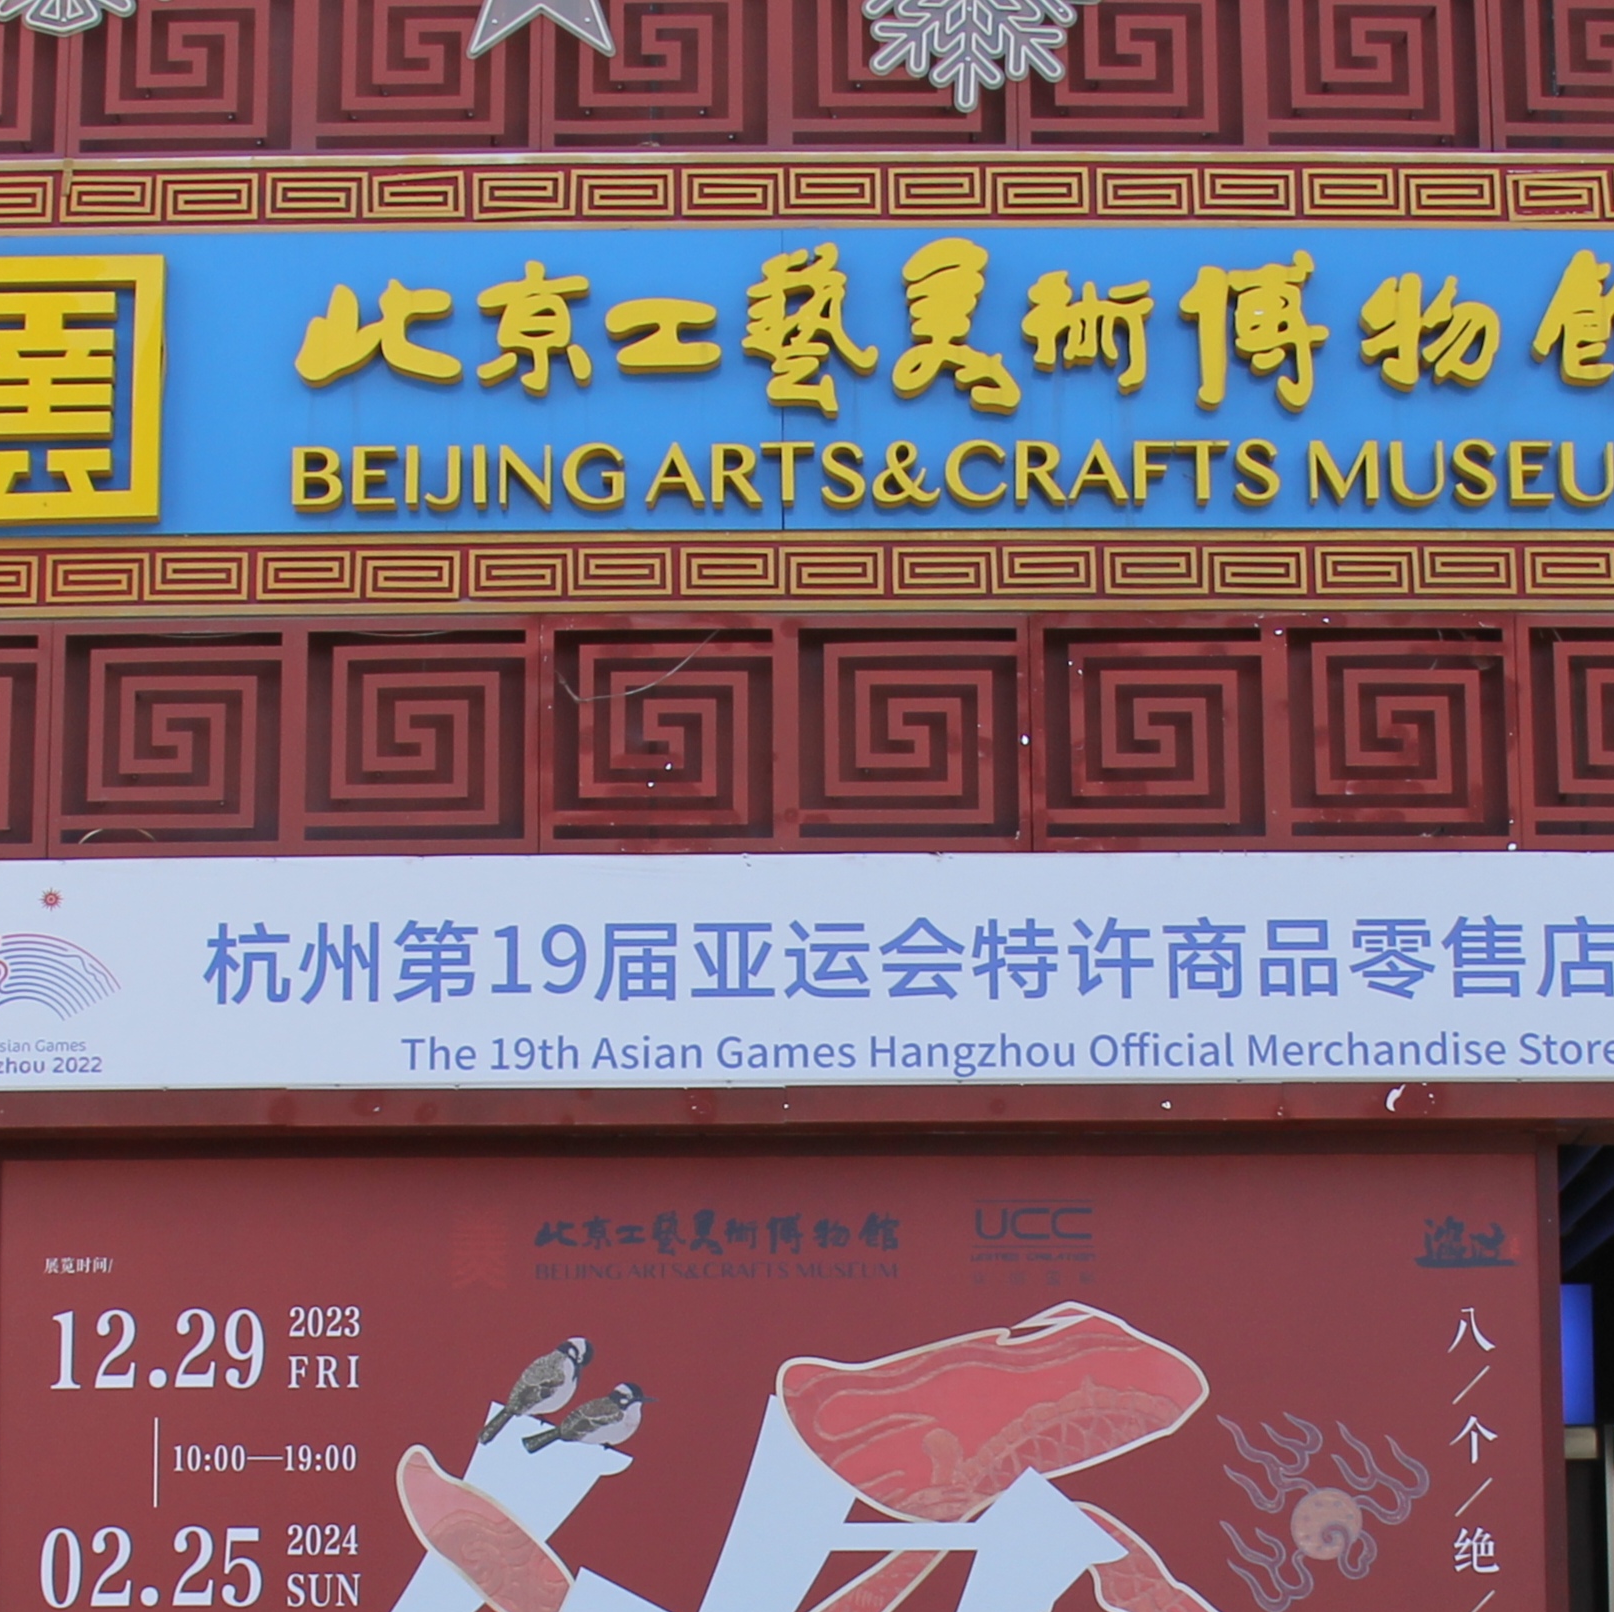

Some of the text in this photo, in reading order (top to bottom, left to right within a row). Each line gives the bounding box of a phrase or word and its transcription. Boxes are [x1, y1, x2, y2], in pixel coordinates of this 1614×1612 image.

[292, 442, 626, 512] BEIJING
[645, 438, 1281, 512] ARTS&CRAFTS
[35, 1038, 87, 1053] Games
[401, 1036, 477, 1072] The
[490, 1035, 580, 1072] 19th
[591, 1035, 703, 1071] Asian
[715, 1034, 857, 1070] Games
[868, 1031, 1076, 1078] Hangzhou
[1089, 1031, 1233, 1068] Official
[1247, 1030, 1507, 1067] Merchandise
[52, 1056, 103, 1074] 2022
[974, 1207, 1093, 1240] UCC
[43, 1257, 114, 1275] 展览时间/
[535, 1260, 899, 1281] BEIJING ARTS&CRAFTS MUSEUM
[50, 1306, 362, 1390] 12.29 2023
[287, 1355, 361, 1389] FRI
[39, 1524, 360, 1609] 02.25 2024
[286, 1572, 362, 1607] SUN
